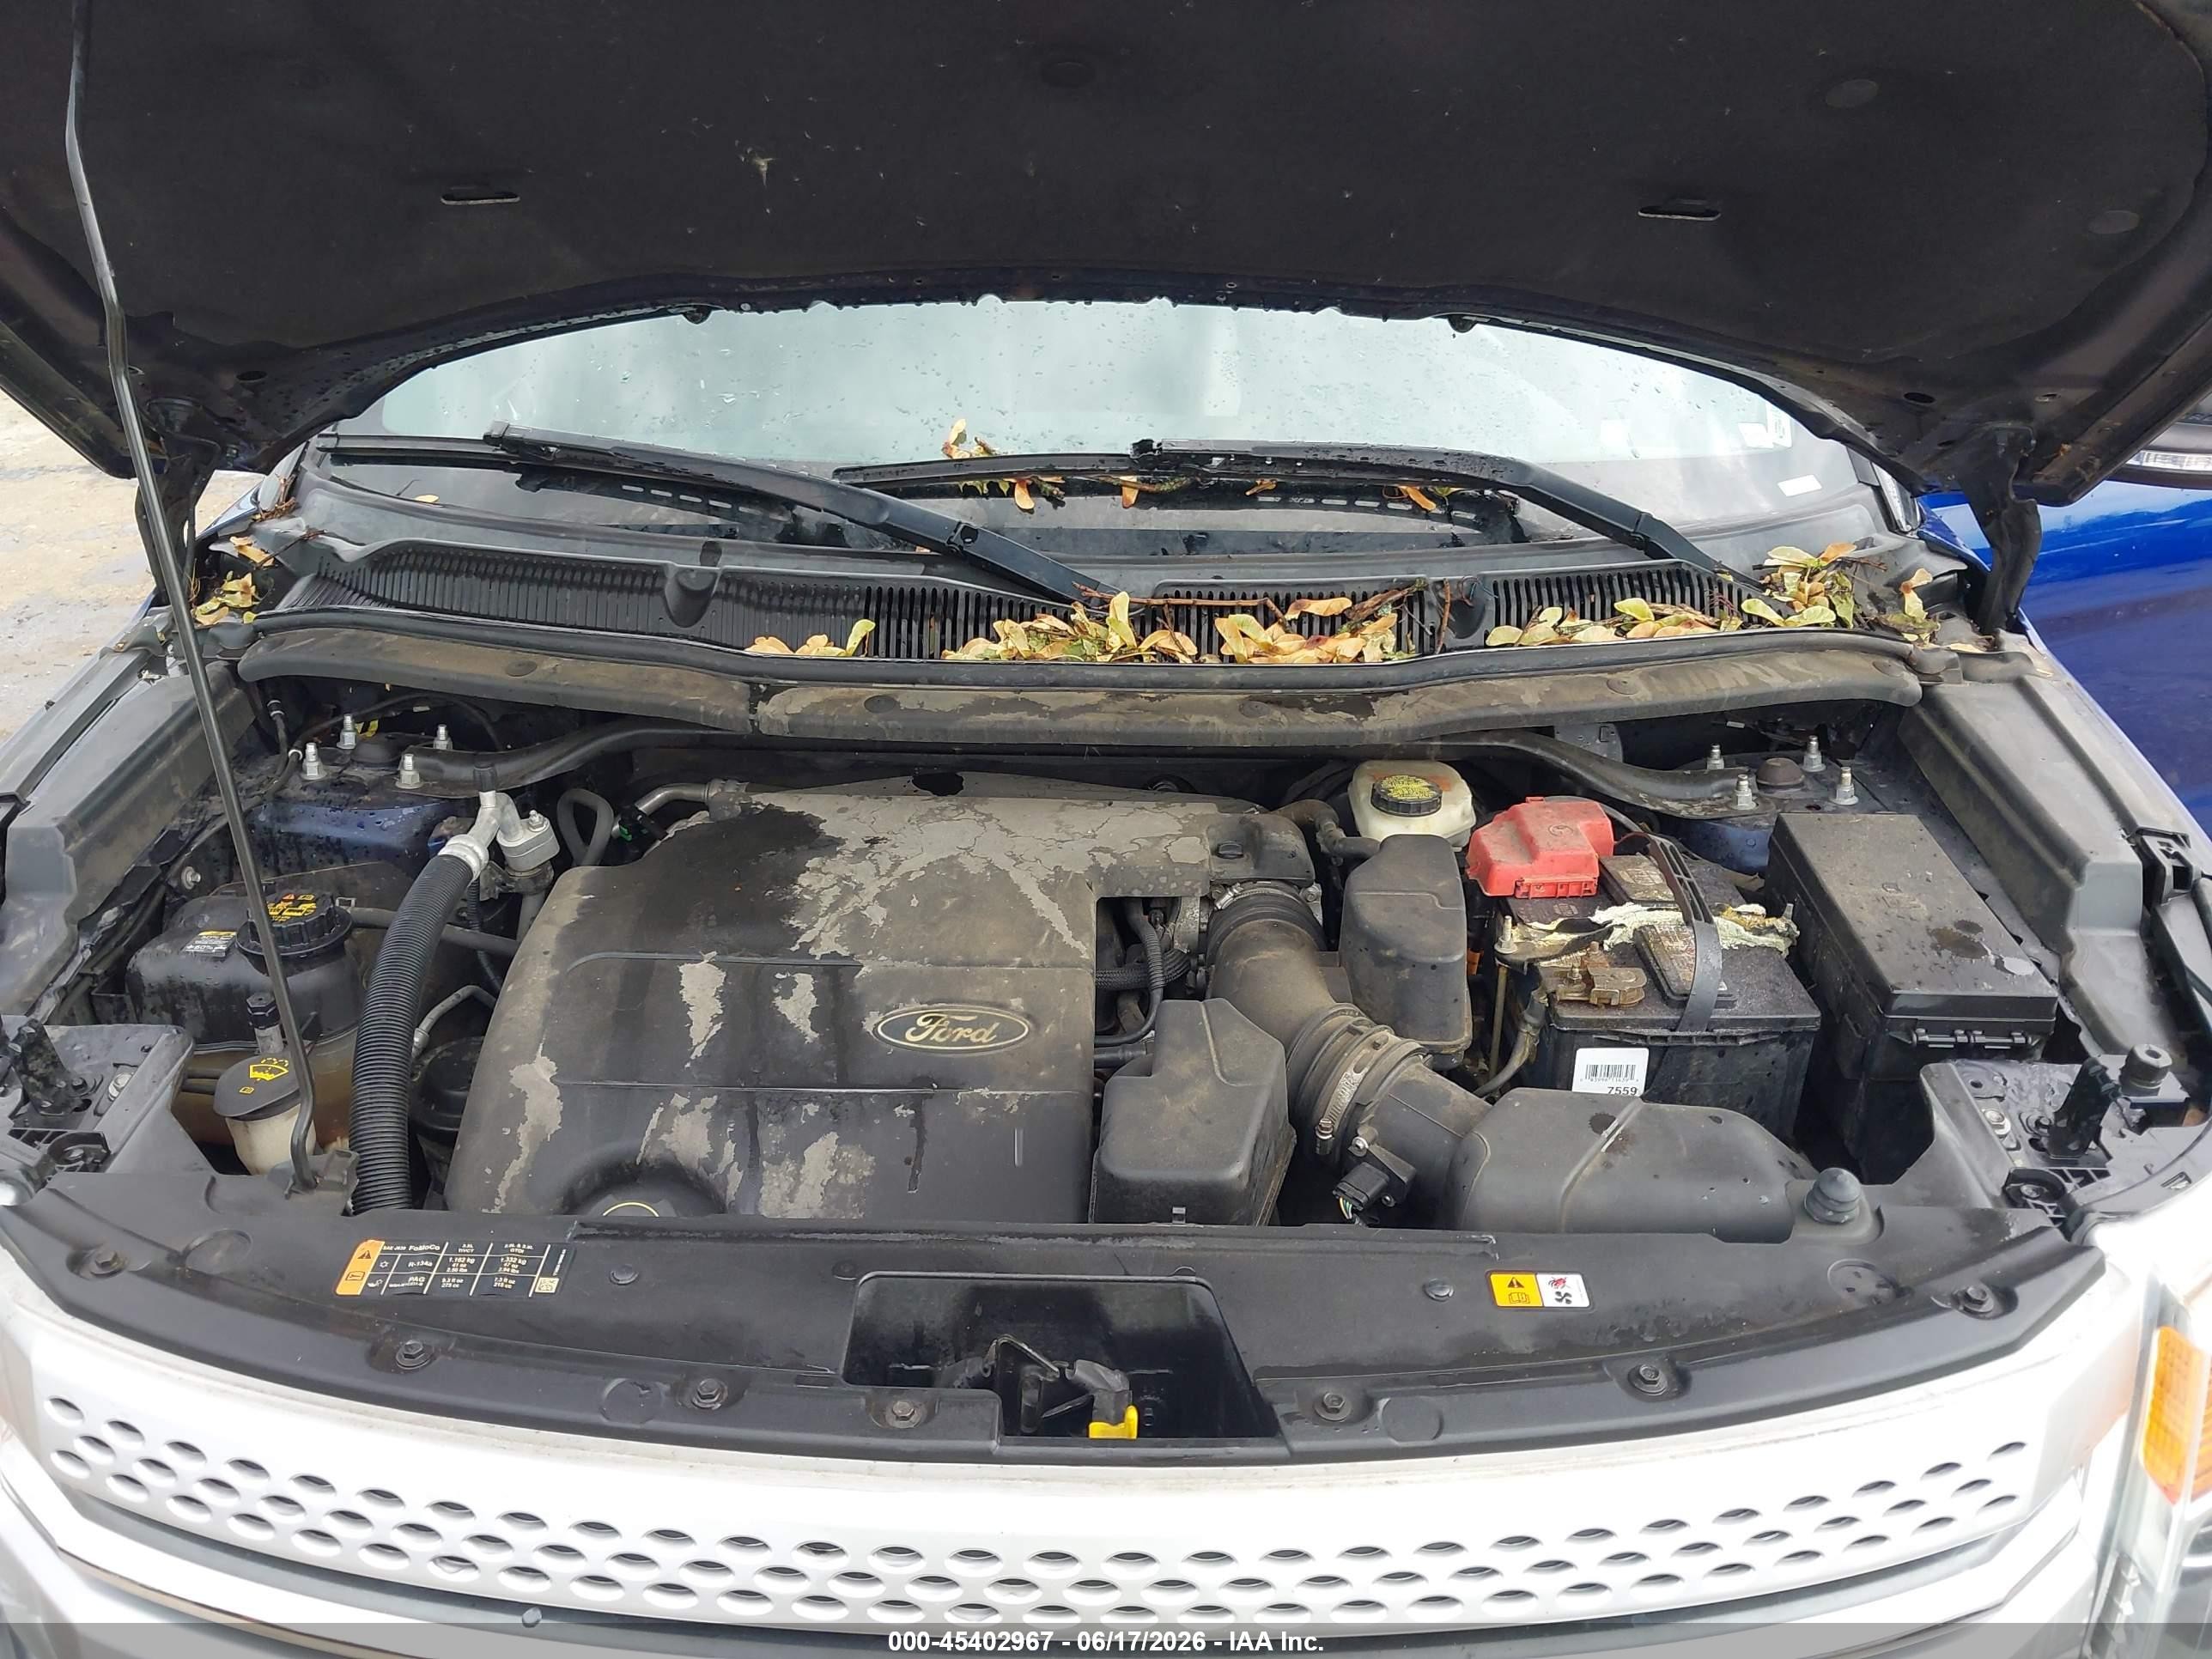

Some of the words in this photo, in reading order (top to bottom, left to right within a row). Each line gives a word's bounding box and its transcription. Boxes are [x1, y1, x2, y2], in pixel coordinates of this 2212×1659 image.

[905, 1012, 1000, 1043] Ford
[1607, 1086, 1638, 1096] 7559
[518, 1257, 527, 1266] kg
